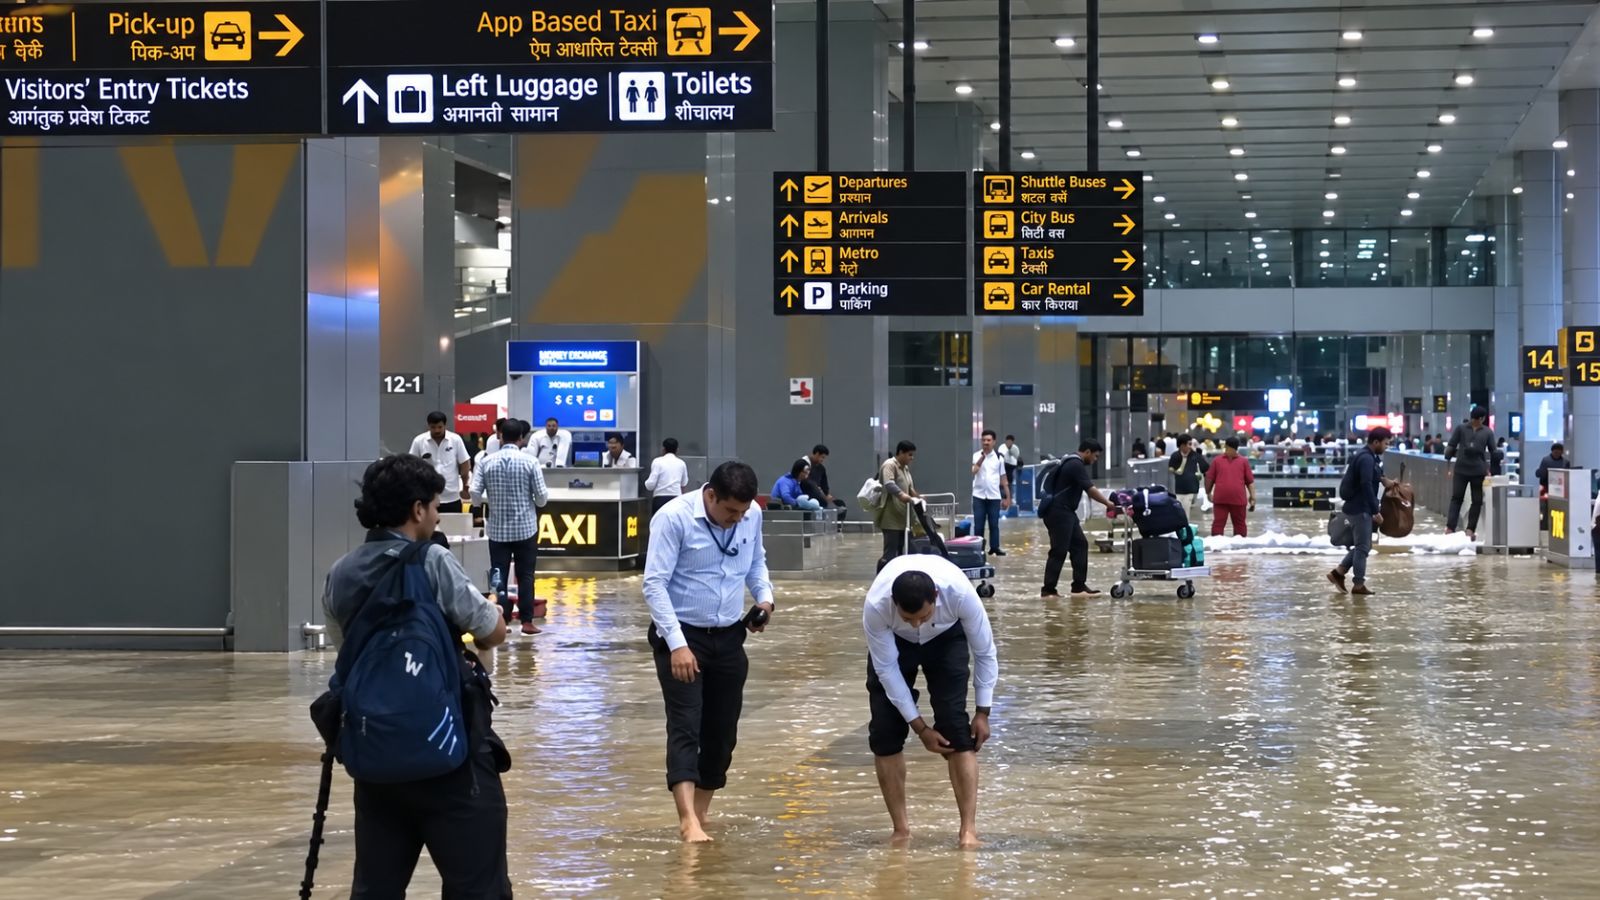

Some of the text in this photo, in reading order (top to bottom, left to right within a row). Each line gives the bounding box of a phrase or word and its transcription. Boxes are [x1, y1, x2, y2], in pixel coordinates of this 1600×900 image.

[110, 12, 194, 39] Pick-up
[478, 9, 656, 37] App Based Taxi
[131, 40, 195, 60] पिक-अप
[557, 37, 614, 57] आधारित
[99, 78, 160, 104] Entry
[166, 77, 248, 99] Tickets
[443, 73, 598, 101] Left Luggage
[672, 71, 752, 94] Toilets
[68, 105, 104, 125] प्रवेश
[108, 105, 150, 125] टिकट
[443, 102, 559, 122] अमानती सामान
[840, 176, 907, 190] Departures
[1021, 176, 1106, 188] Shuttle Buses
[839, 211, 888, 223] Arrivals
[1021, 211, 1074, 226] City Bus
[840, 229, 874, 238] आगमन
[840, 247, 878, 259] Metro
[1021, 246, 1054, 259] Taxis
[840, 282, 887, 298] Parking
[1022, 282, 1090, 294] Car Rental
[1022, 301, 1040, 310] कार
[1528, 350, 1554, 369] 14
[1577, 363, 1600, 381] 15
[384, 376, 419, 392] 12-1
[537, 514, 596, 544] AXI
